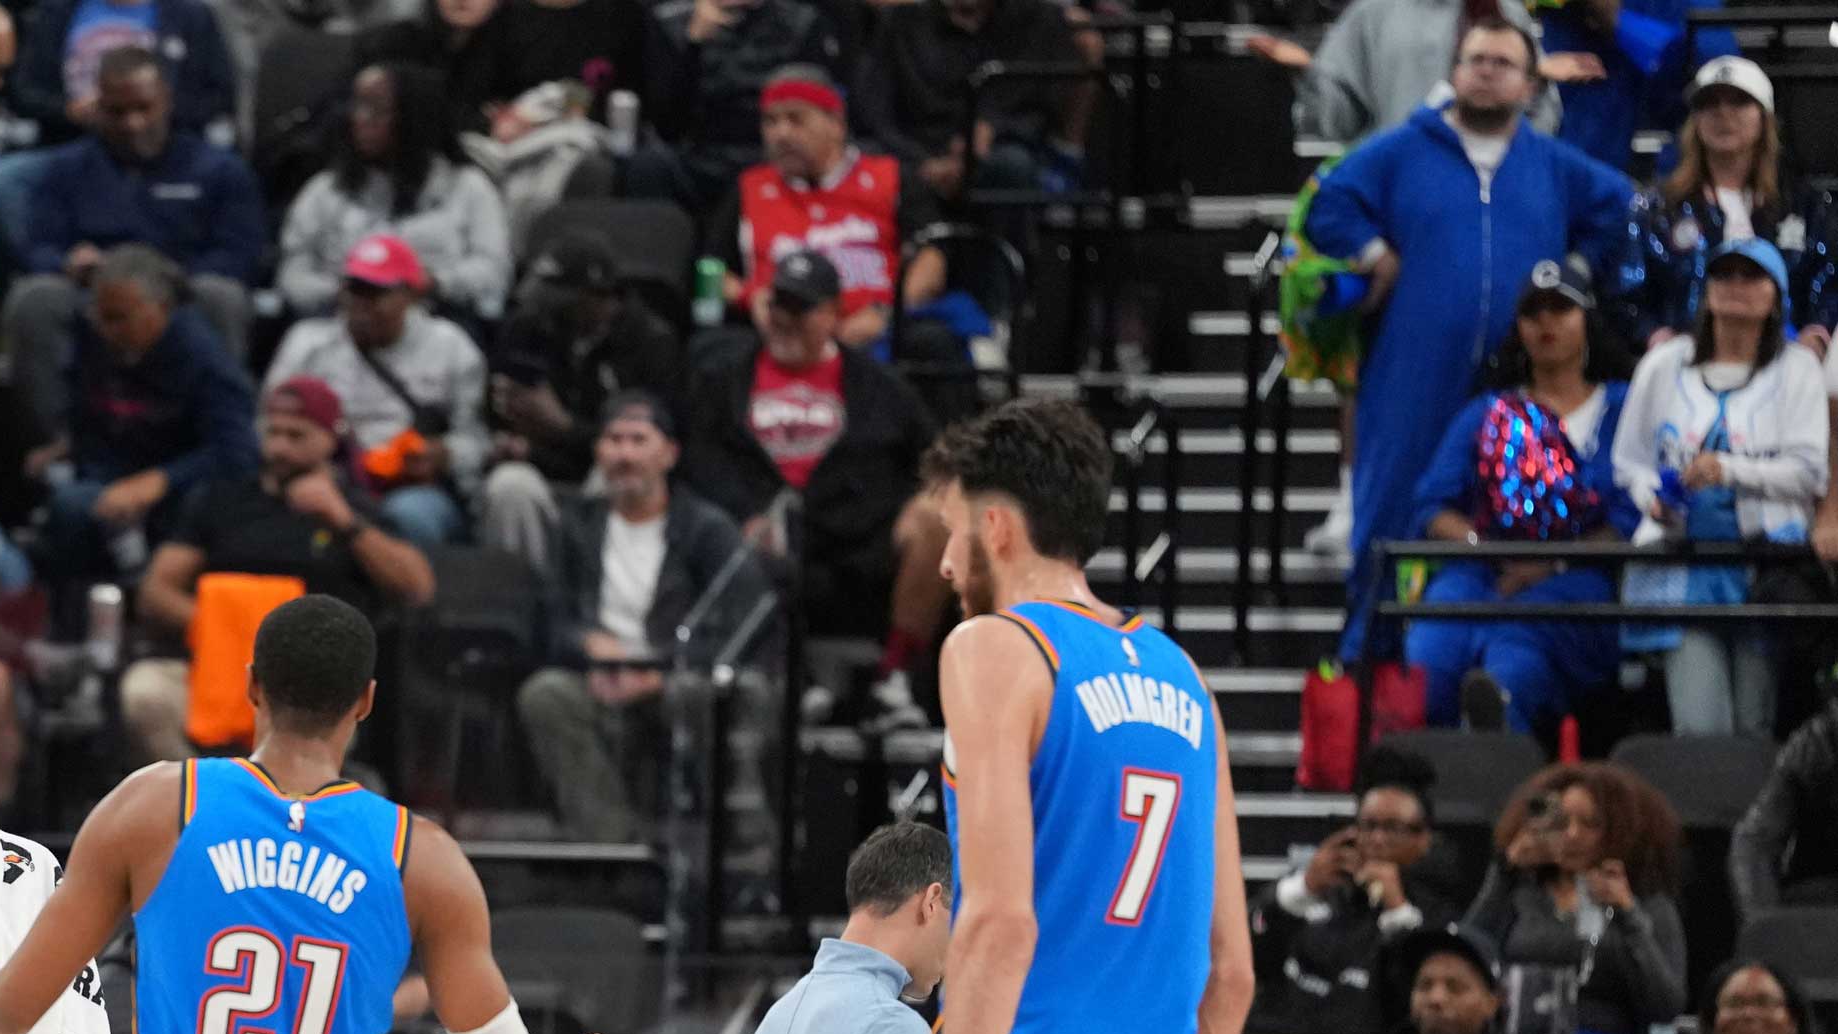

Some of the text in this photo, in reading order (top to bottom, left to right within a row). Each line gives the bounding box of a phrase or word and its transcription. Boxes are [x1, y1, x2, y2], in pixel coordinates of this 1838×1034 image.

[1075, 672, 1203, 751] HOLMGREN
[207, 837, 368, 914] WIGGINS
[1105, 766, 1181, 927] 7
